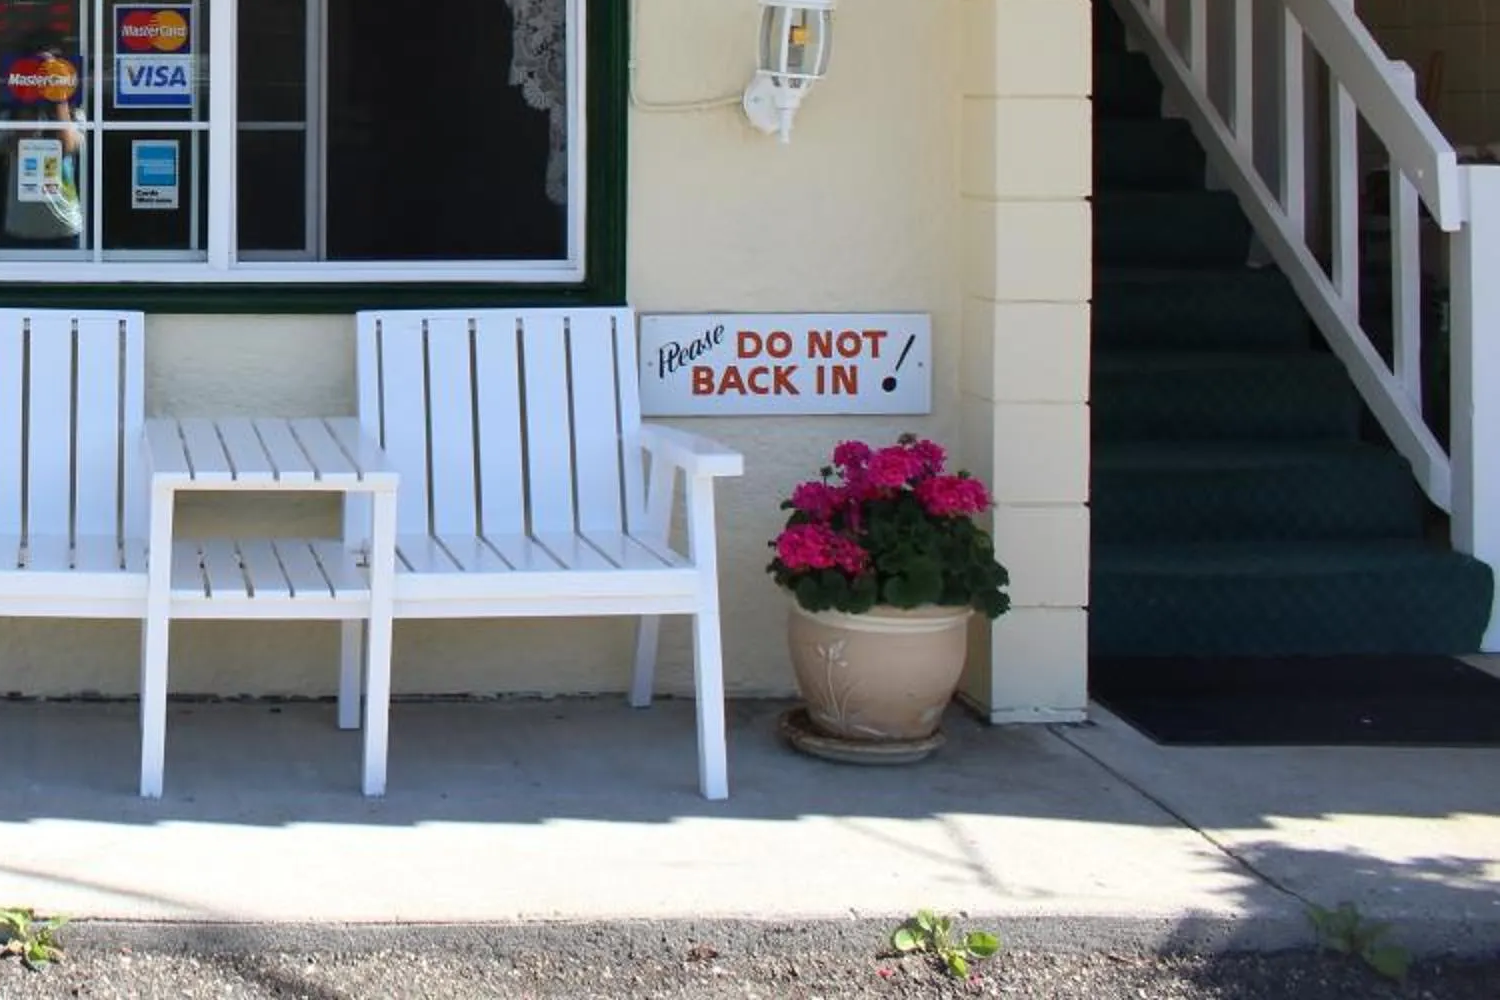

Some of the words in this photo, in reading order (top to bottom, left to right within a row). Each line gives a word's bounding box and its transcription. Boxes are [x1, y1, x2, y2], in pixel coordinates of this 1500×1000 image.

[121, 25, 187, 38] MasterCard
[8, 72, 77, 88] MasterCard
[126, 65, 187, 87] VISA
[659, 323, 726, 379] Please
[736, 330, 793, 358] DO
[807, 330, 888, 358] NOT
[691, 365, 800, 396] BACK
[815, 366, 859, 395] IN
